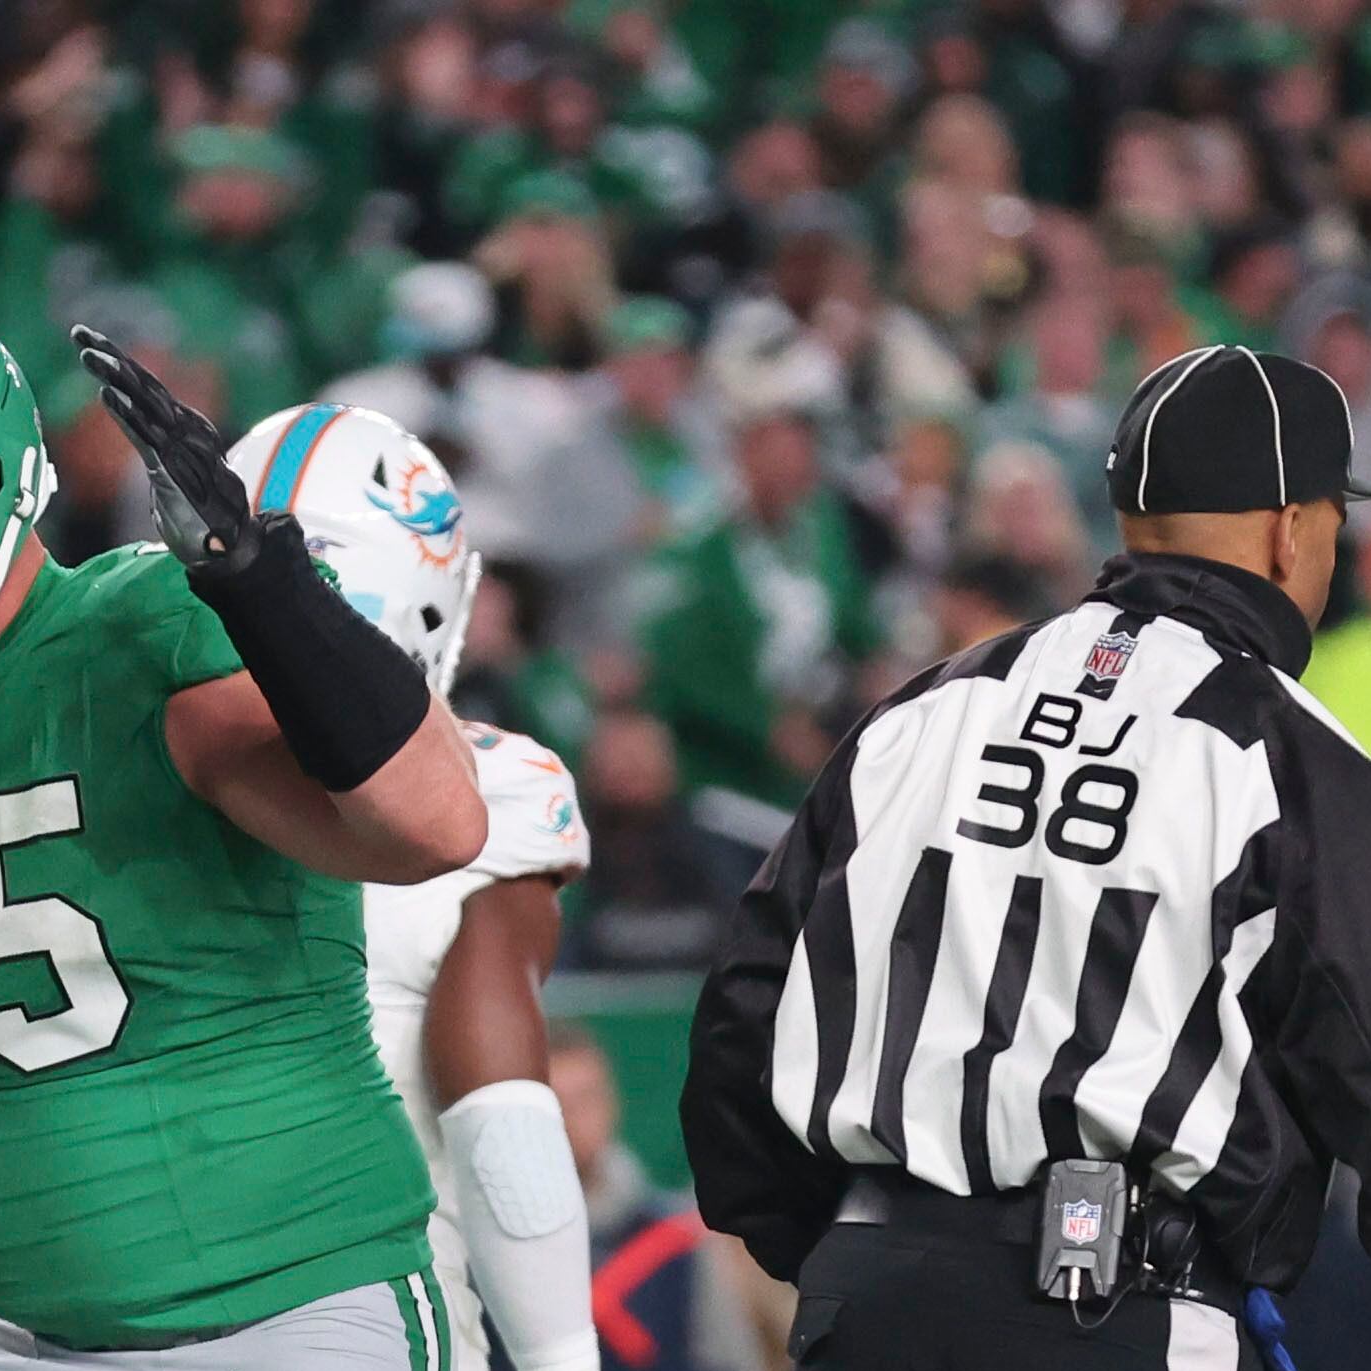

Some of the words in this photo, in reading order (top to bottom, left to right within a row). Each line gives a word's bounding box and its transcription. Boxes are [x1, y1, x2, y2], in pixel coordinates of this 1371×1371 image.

[1089, 651, 1126, 677] NFL
[1019, 692, 1139, 757] BJ
[956, 743, 1139, 866] 38
[1068, 1221, 1095, 1237] NFL
